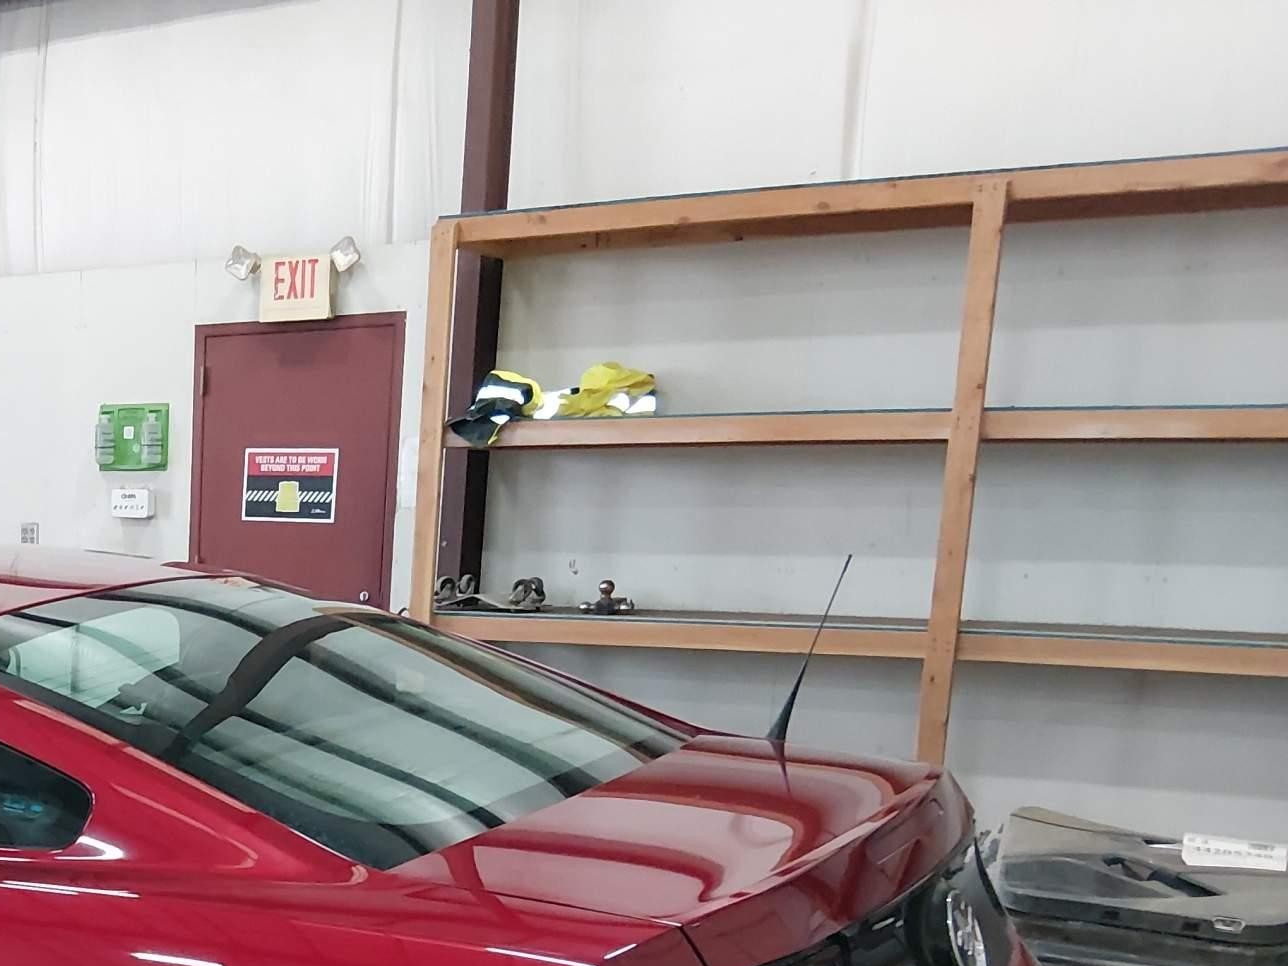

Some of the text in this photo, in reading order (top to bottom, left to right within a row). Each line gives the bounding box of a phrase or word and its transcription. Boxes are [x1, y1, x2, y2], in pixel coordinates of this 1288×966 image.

[273, 258, 319, 300] EXIT
[255, 456, 275, 464] VESTS
[275, 456, 287, 464] ARE
[289, 456, 297, 464] TO
[307, 456, 328, 464] WORN
[260, 464, 321, 472] BEYOND THIS POINT
